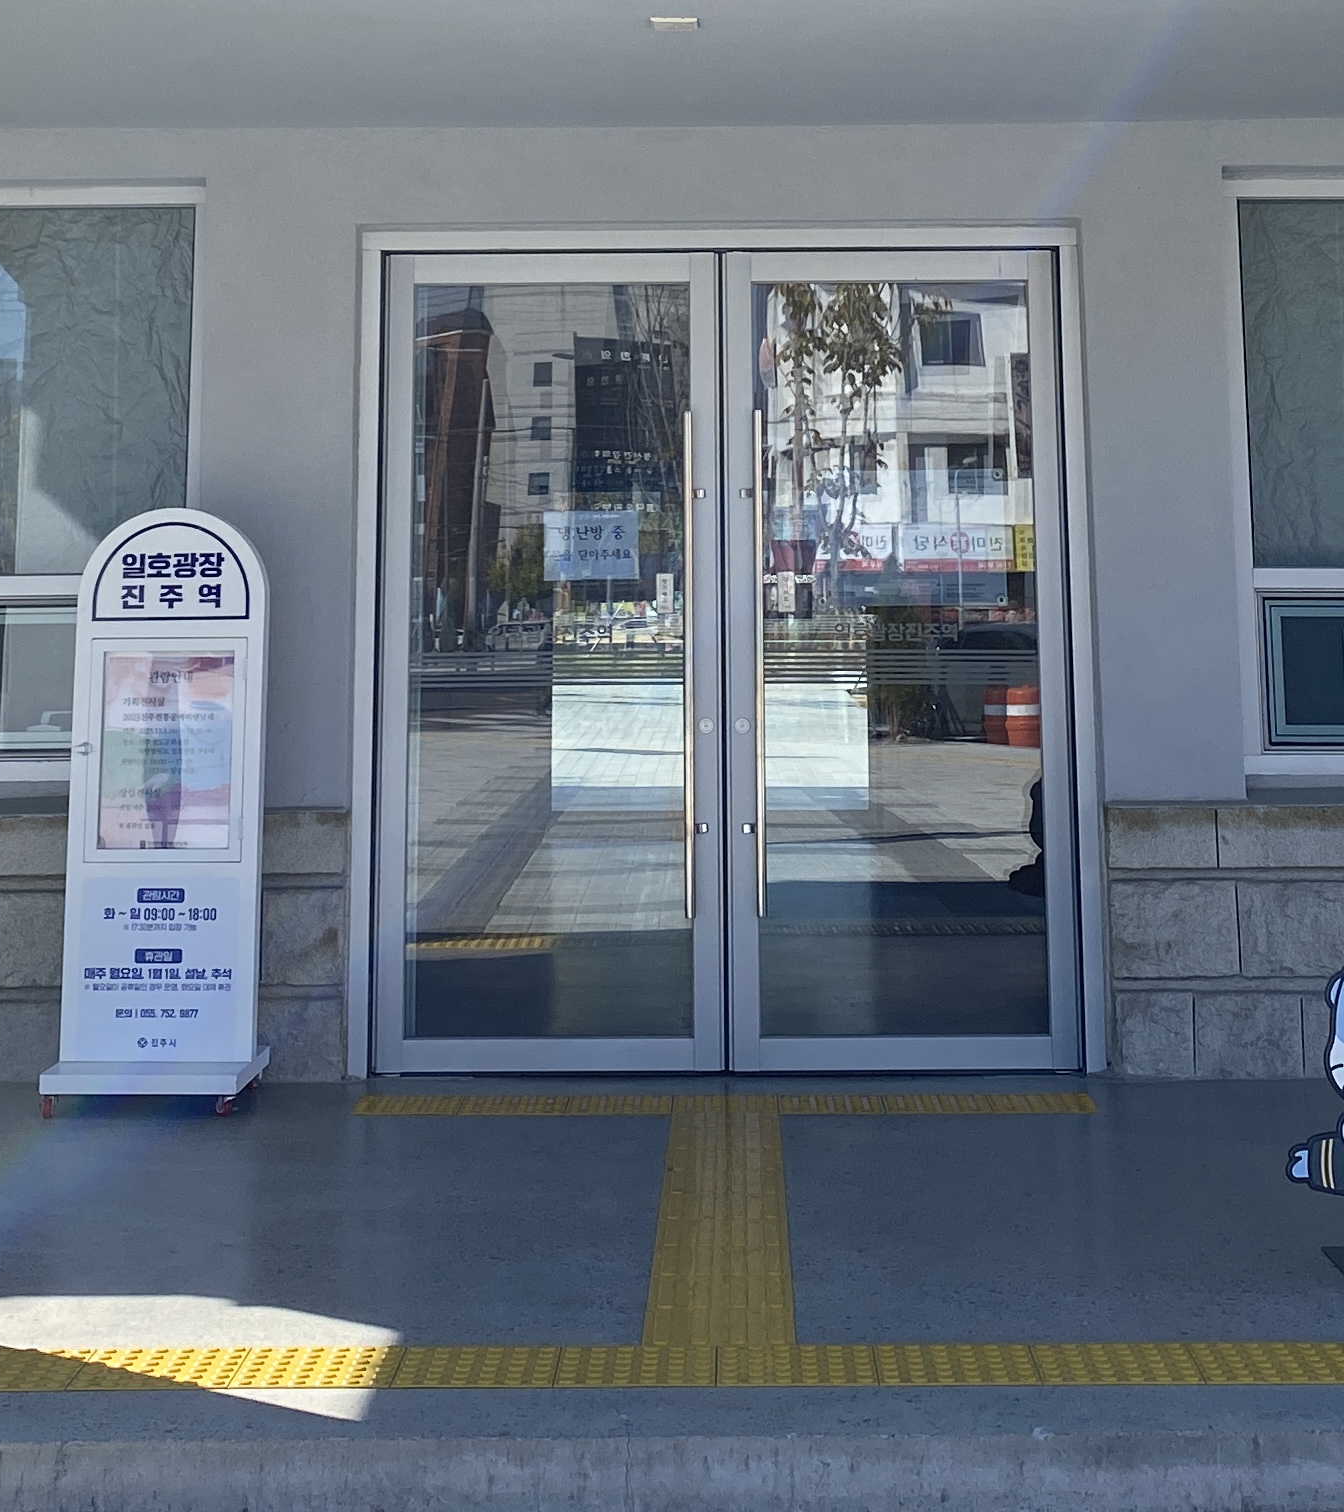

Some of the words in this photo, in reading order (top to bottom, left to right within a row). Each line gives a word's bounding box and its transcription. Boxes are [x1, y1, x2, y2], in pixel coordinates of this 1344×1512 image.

[611, 525, 625, 540] 중
[578, 549, 632, 561] 닫아주세요
[122, 552, 225, 578] 일호광장
[121, 584, 222, 609] 진주역
[149, 670, 193, 684] 관람안내
[142, 889, 180, 901] 관람시간
[103, 907, 115, 920] 화
[129, 907, 141, 920] 일
[143, 907, 175, 921] 09:00
[188, 907, 217, 921] 18:00
[144, 951, 173, 962] 휴관일
[84, 967, 106, 979] 매주
[148, 967, 162, 979] 1월
[211, 967, 232, 979] 추석
[115, 1008, 132, 1018] 문의
[151, 1038, 176, 1048] 진주시
